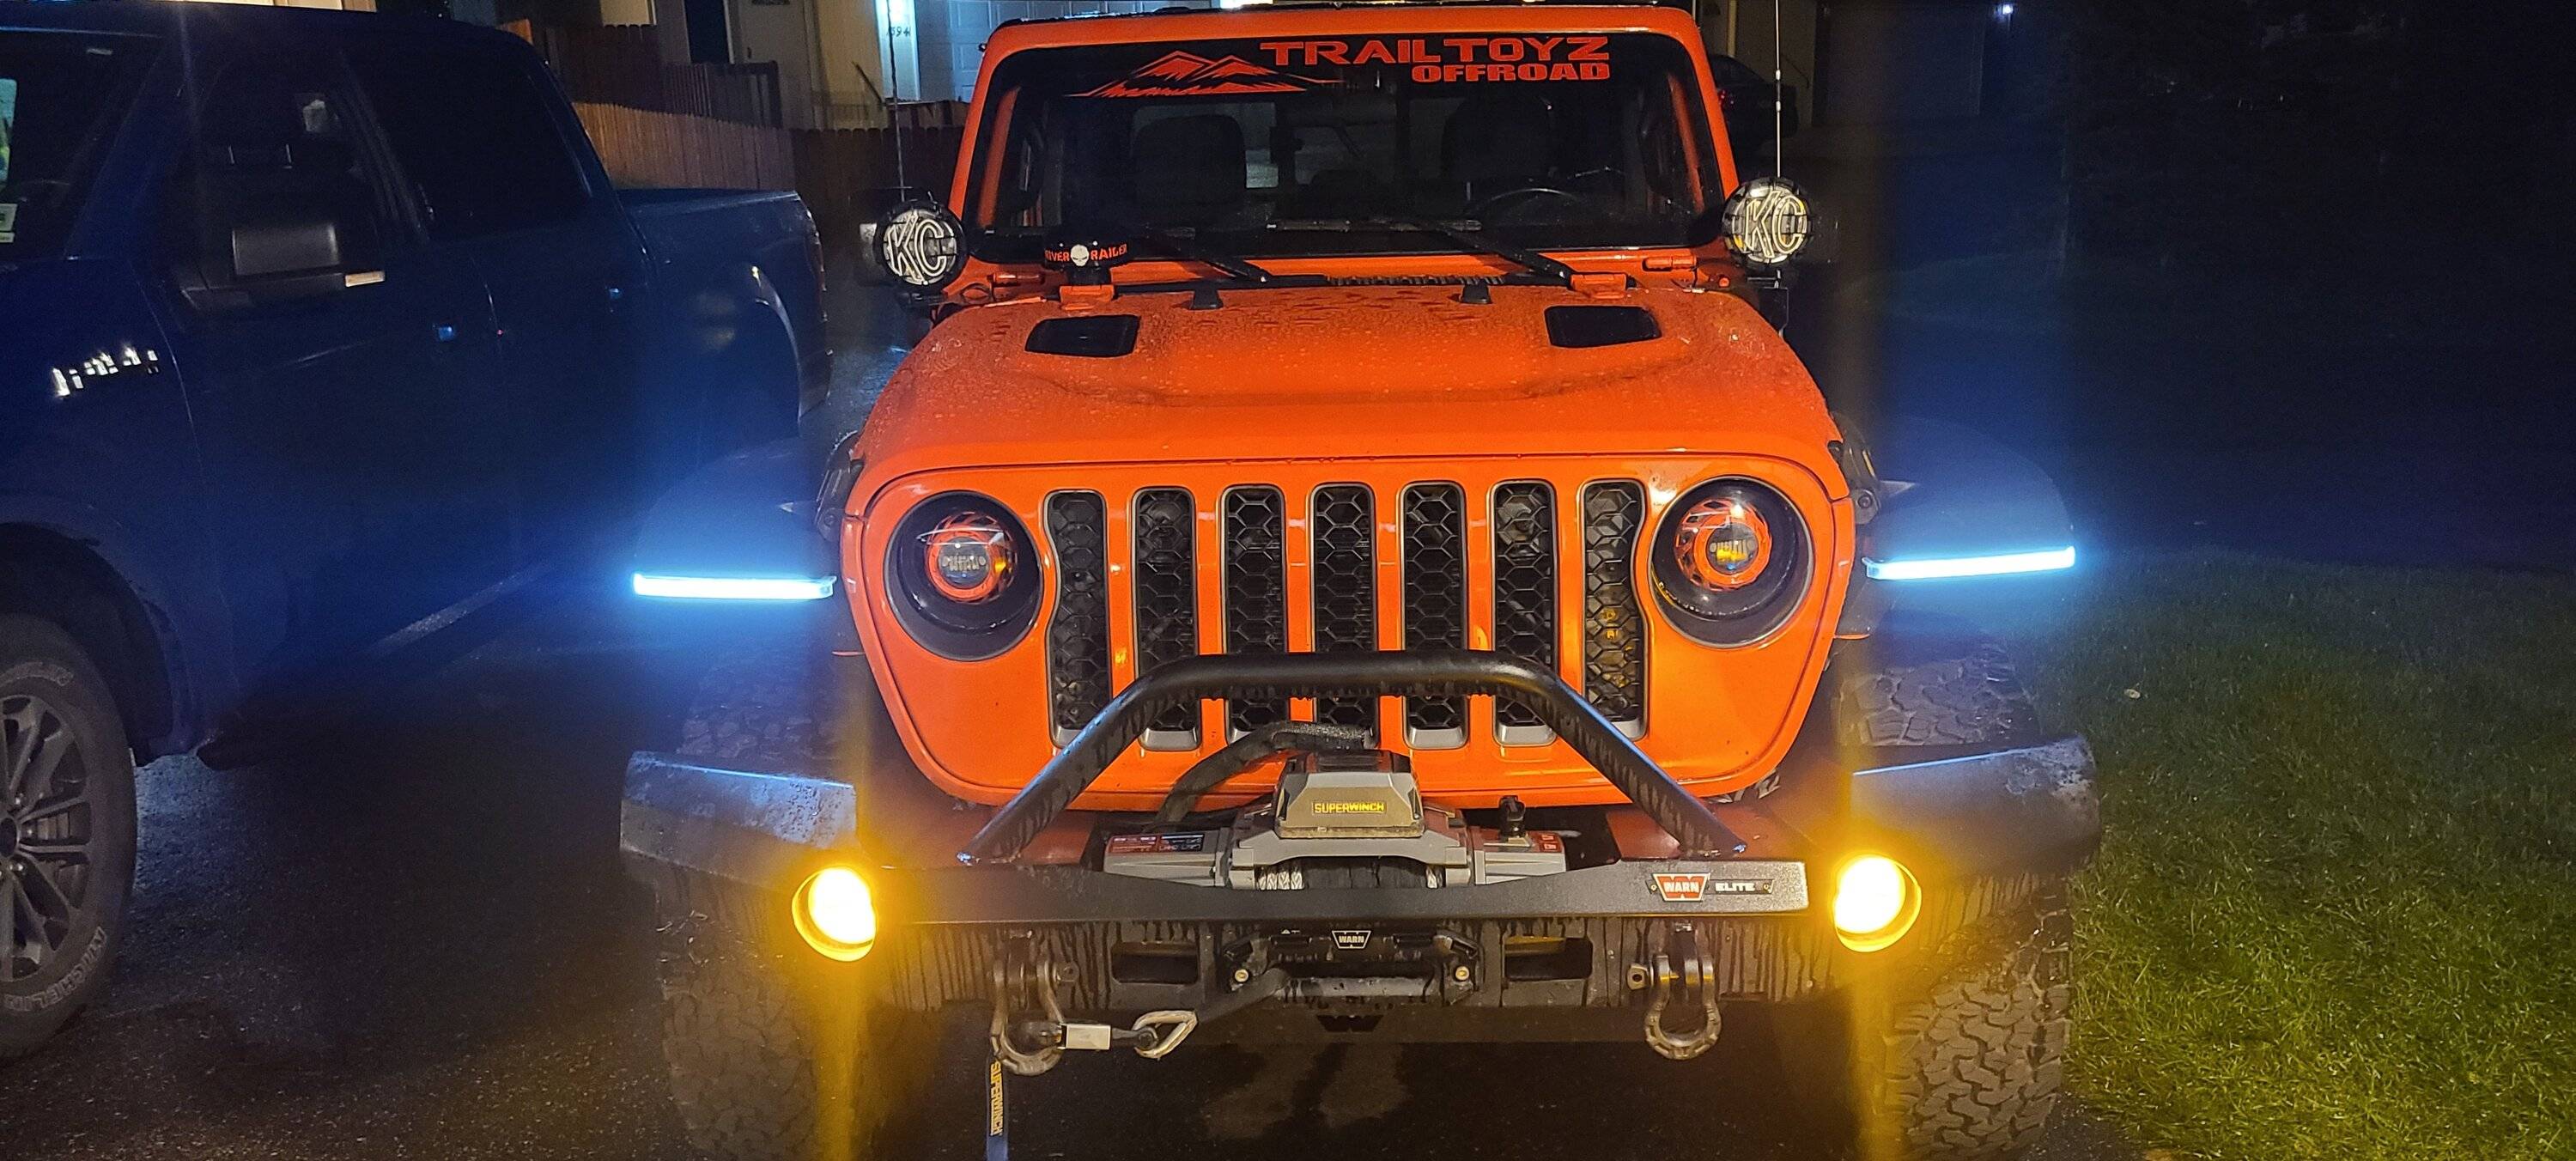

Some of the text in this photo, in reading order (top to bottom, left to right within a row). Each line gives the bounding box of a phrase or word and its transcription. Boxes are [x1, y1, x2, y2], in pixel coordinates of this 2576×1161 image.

[1412, 63, 1611, 82] OFFROAD
[1744, 190, 1807, 258] KC
[887, 209, 947, 282] KC
[1044, 250, 1070, 262] RIVER
[1314, 801, 1384, 814] SUPERWINCH
[1663, 882, 1755, 893] WARN ELITE
[1339, 935, 1364, 944] WARN
[990, 1061, 1004, 1136] SUPERWINCH
